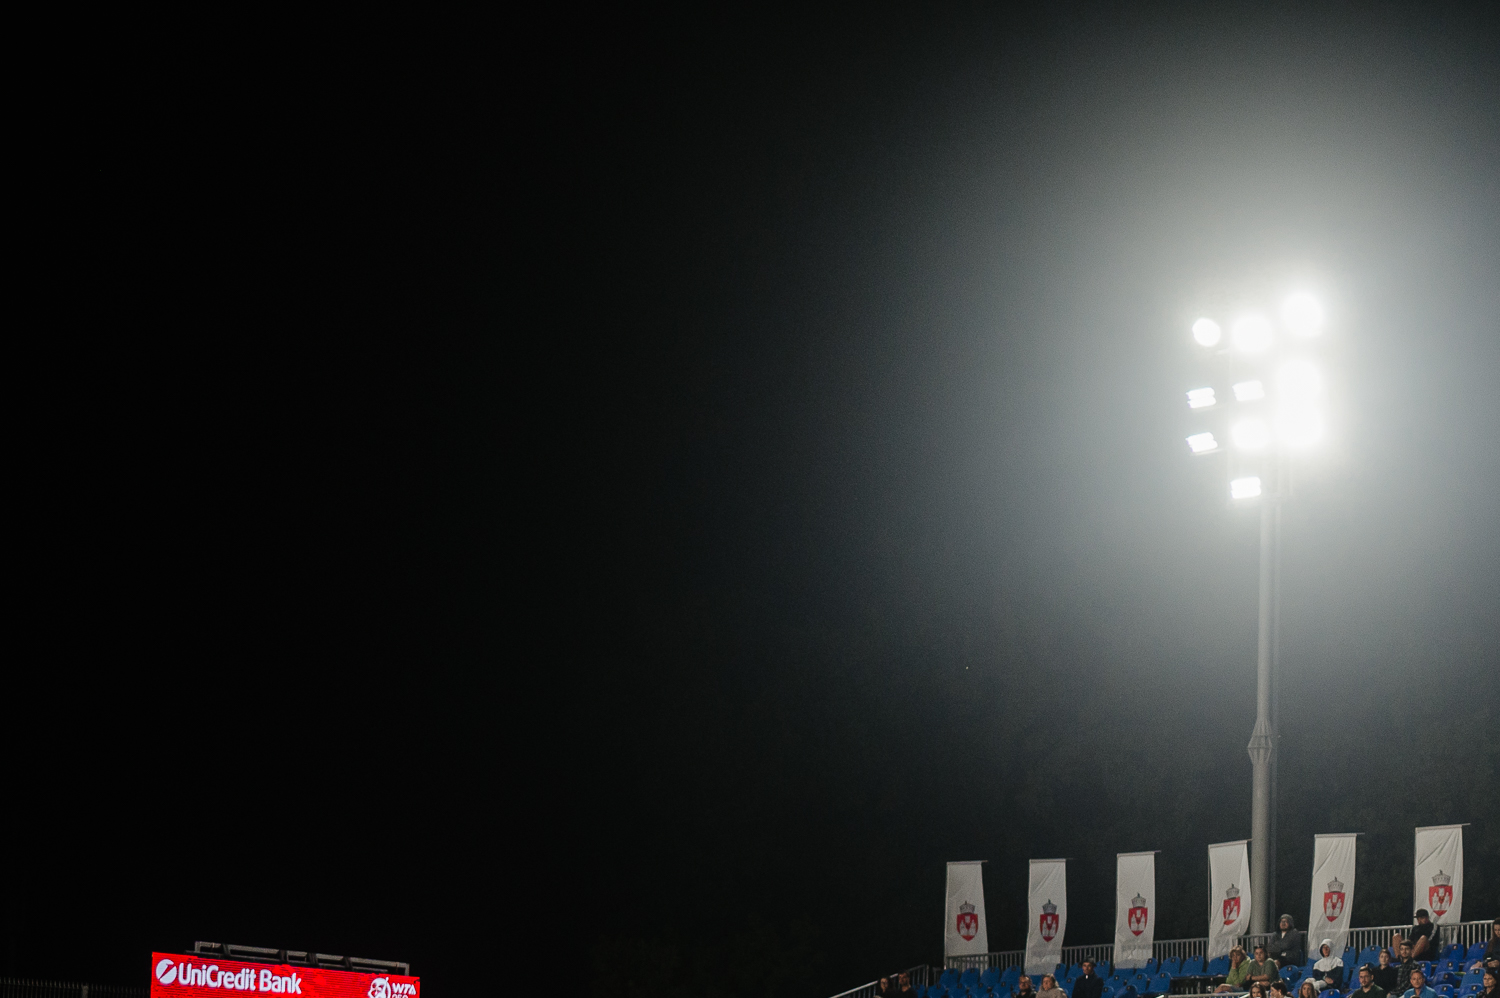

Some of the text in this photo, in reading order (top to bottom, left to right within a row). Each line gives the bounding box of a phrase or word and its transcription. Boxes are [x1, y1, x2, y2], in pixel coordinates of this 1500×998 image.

[178, 962, 302, 994] UniCredit Bank
[391, 982, 416, 995] WTA
